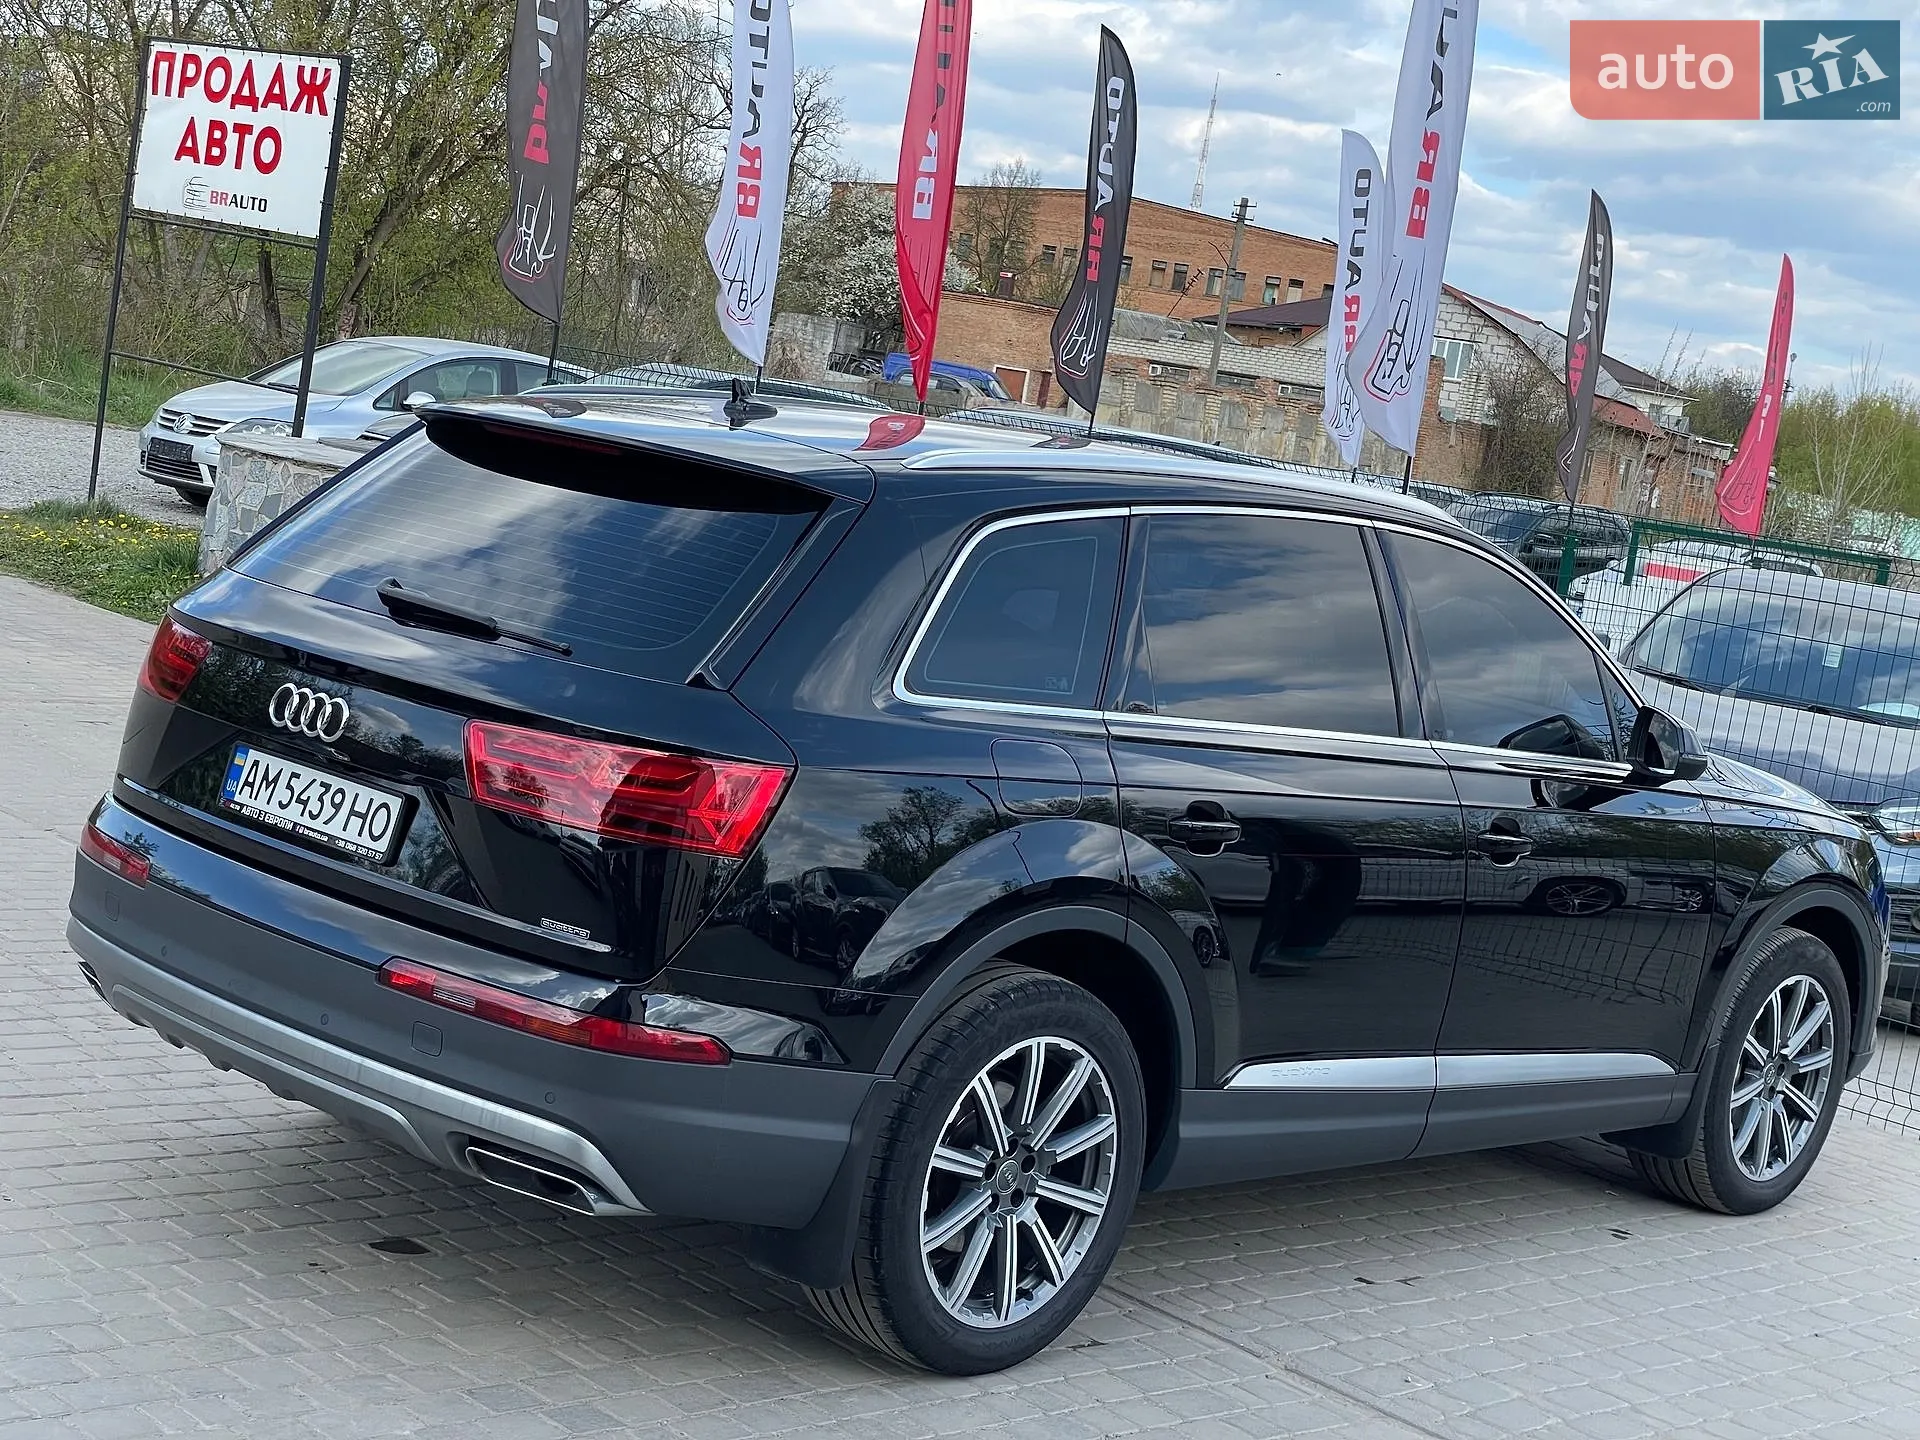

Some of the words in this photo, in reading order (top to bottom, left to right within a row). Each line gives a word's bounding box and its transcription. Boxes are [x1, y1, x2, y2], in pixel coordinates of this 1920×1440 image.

[151, 50, 332, 117] ПРОДАЖ
[174, 116, 283, 175] АВТО
[209, 190, 269, 213] BRAUTO
[226, 778, 237, 793] UA
[238, 759, 284, 806] AM
[278, 771, 347, 826] 5439
[341, 792, 392, 843] HO
[240, 805, 260, 819] АВТО
